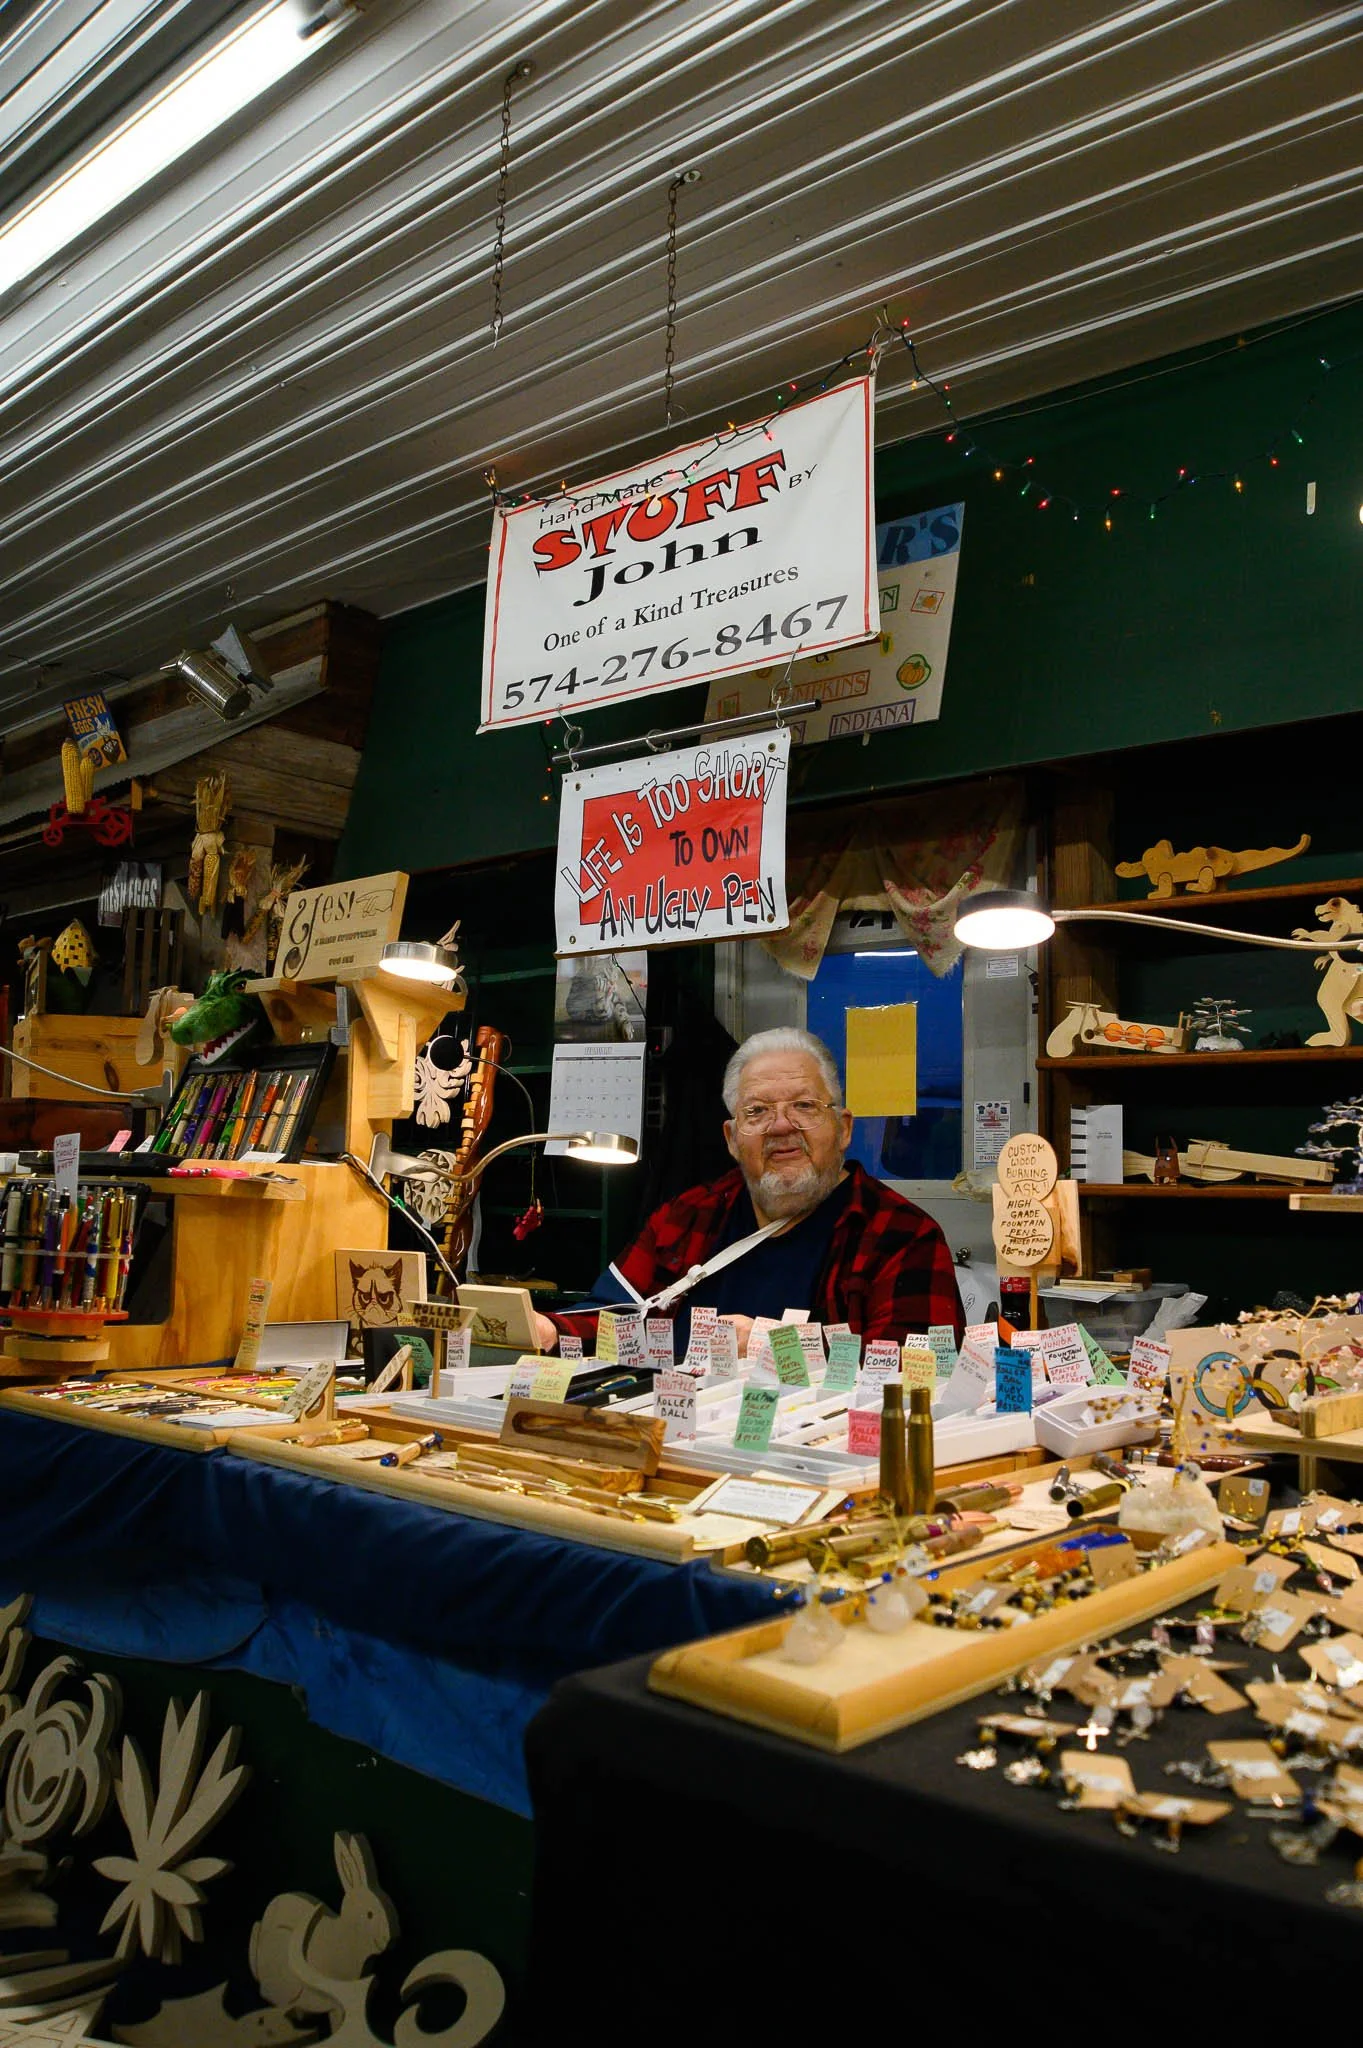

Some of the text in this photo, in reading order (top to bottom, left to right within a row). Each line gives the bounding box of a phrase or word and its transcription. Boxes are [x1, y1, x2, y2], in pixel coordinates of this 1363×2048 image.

[788, 463, 818, 489] BY
[539, 475, 664, 529] Hand Made
[532, 449, 787, 582] STUFF
[573, 526, 763, 607] John
[543, 565, 800, 652] One of a Kind Treasures
[502, 594, 849, 710] 574-276-8467
[833, 703, 910, 733] INDIANA
[560, 749, 786, 905] LIFE IS TOO SHORT
[669, 825, 750, 867] TO OWN
[599, 872, 777, 941] AN UGLY PEN
[1007, 1143, 1046, 1158] CUSTOM
[1010, 1156, 1037, 1167] WOOD
[1006, 1167, 1049, 1180] BURNING
[1014, 1183, 1040, 1195] ASK
[1007, 1199, 1032, 1209] HIGH
[1010, 1209, 1041, 1219] GRADE
[1000, 1219, 1046, 1231] FOUNTAIN
[1009, 1228, 1038, 1237] PENS
[1041, 1325, 1078, 1340] MAJESTIC
[1042, 1336, 1073, 1350] JUNIOR
[1048, 1346, 1082, 1361] FOUNTAIN
[865, 1355, 898, 1368] COMBO
[655, 1377, 696, 1393] SHUTTLE
[656, 1394, 695, 1409] ROLLER
[660, 1407, 689, 1420] BALL
